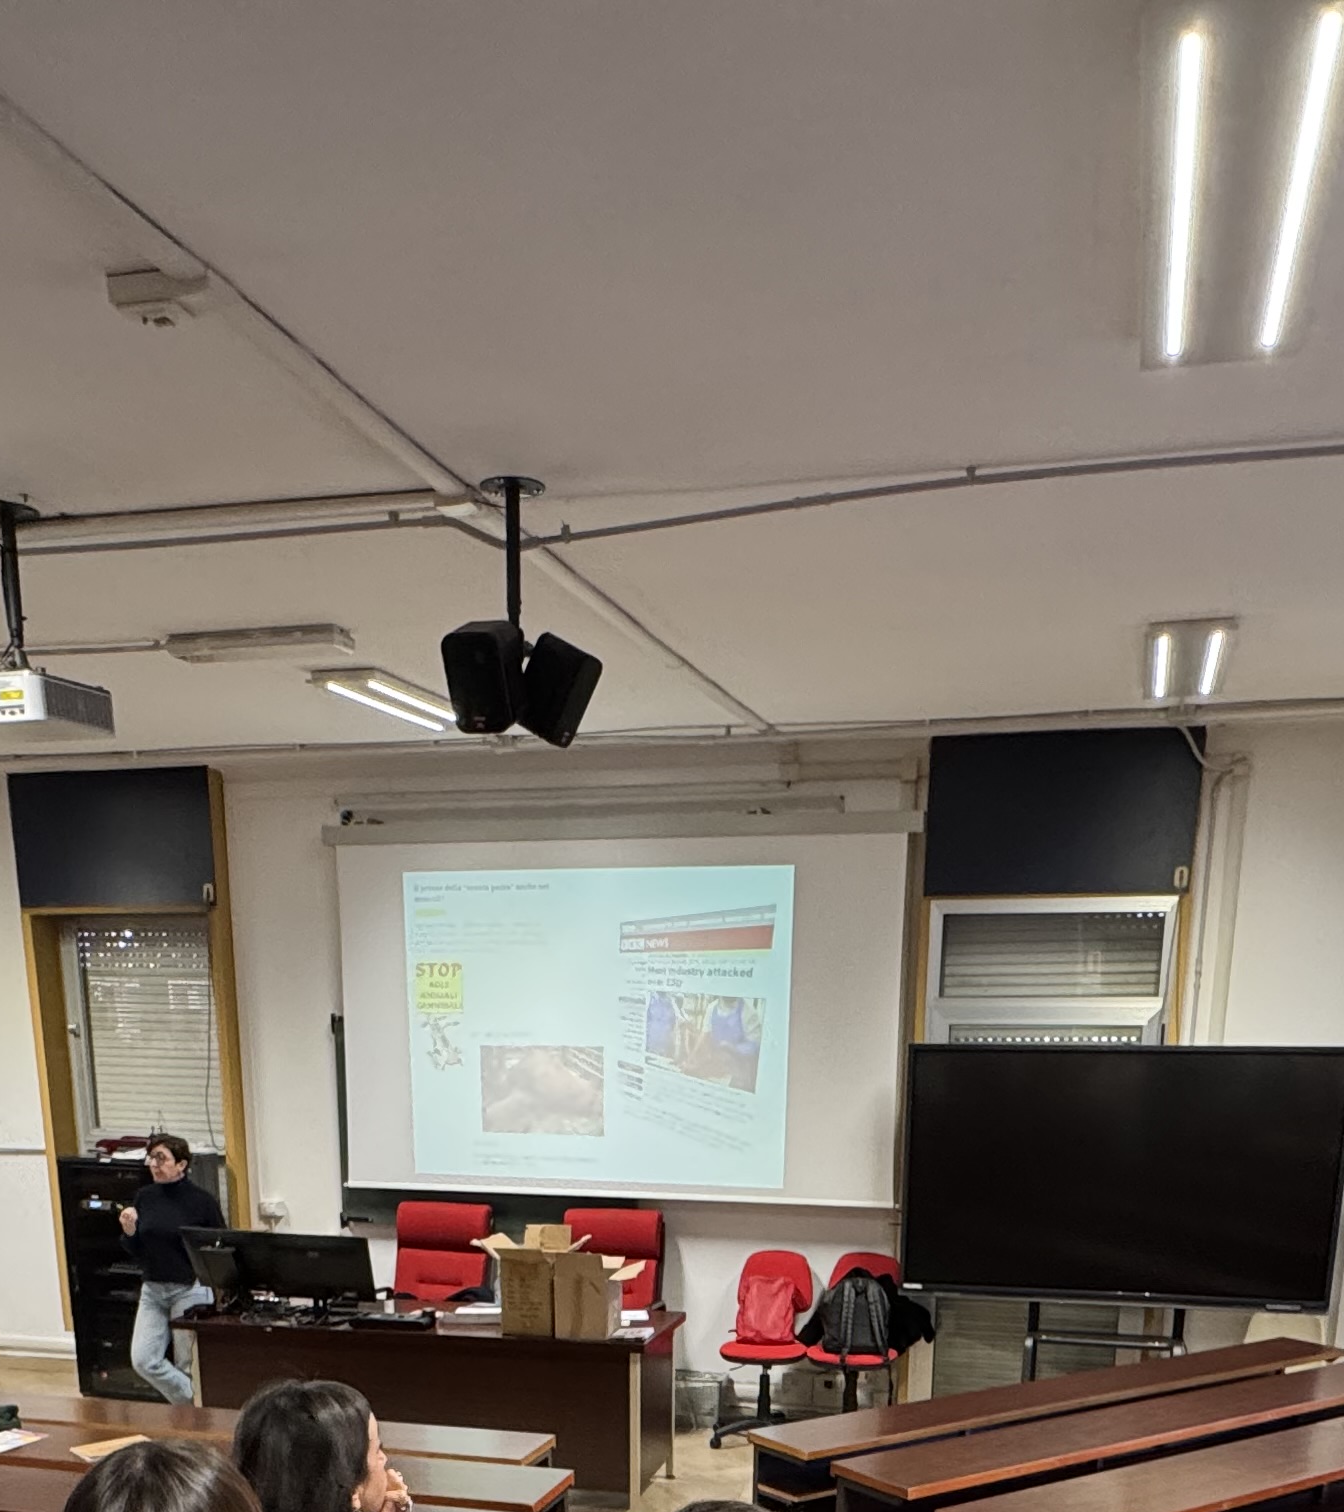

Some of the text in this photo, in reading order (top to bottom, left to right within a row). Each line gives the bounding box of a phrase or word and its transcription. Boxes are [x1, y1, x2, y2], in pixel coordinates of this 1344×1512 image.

[646, 938, 669, 949] NEWS
[415, 962, 462, 978] STOP
[706, 967, 754, 978] attacked
